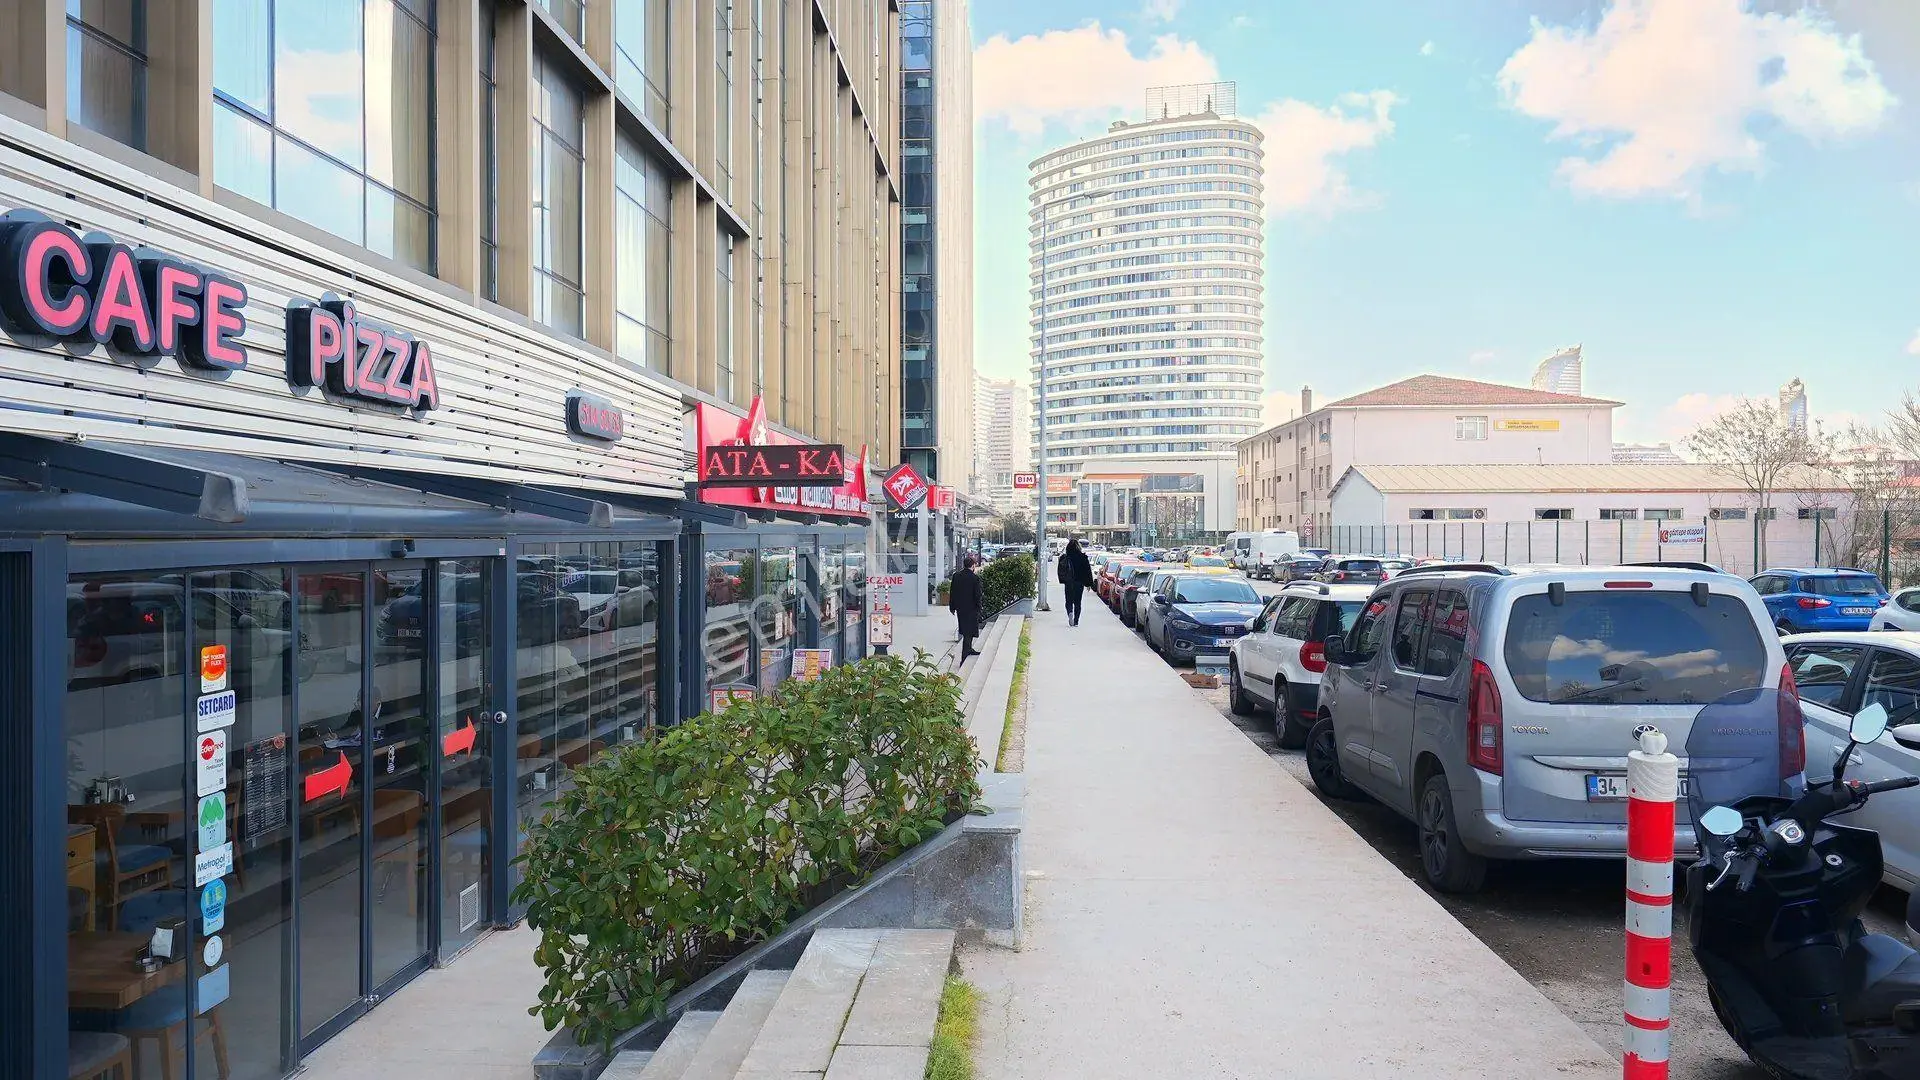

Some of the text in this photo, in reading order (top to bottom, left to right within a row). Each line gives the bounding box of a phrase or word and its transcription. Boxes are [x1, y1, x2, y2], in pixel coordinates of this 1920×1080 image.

[22, 224, 247, 368] CAFE
[706, 451, 772, 475] ATA
[798, 451, 844, 475] KA
[199, 694, 234, 717] SETCARD
[1511, 725, 1550, 735] TOYOTA
[1599, 778, 1617, 795] 34
[197, 853, 226, 873] Metropol
